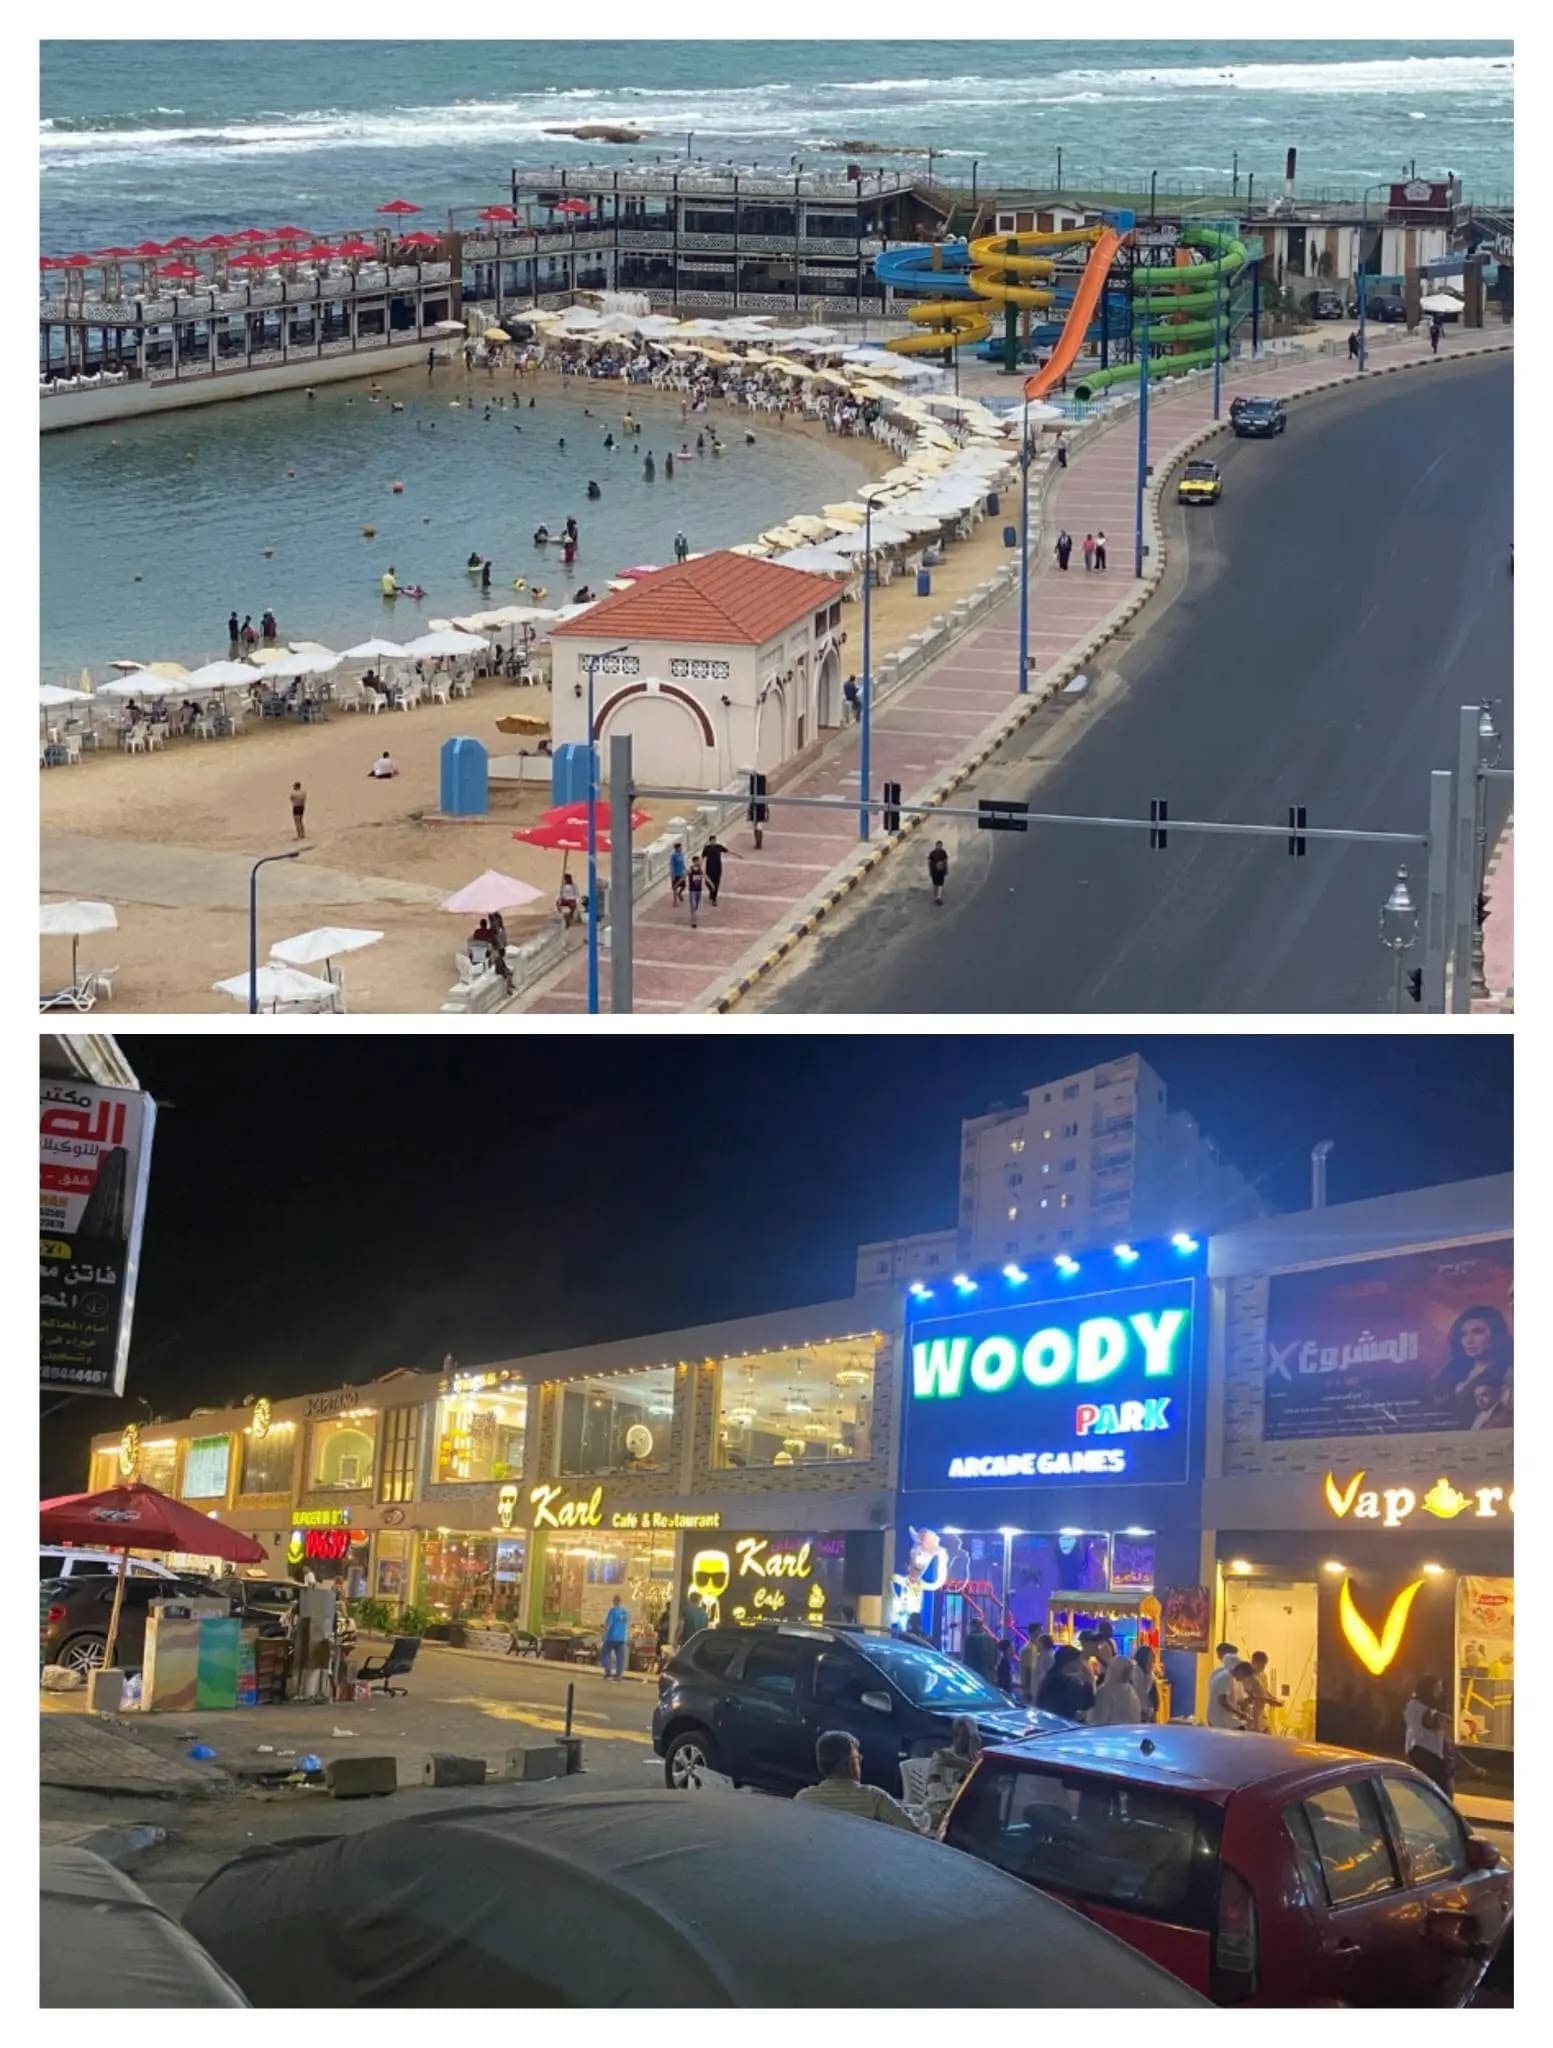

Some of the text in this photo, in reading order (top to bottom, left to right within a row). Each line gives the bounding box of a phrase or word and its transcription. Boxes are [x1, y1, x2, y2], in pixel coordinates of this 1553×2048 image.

[912, 1309, 1189, 1400] WOODY
[1299, 1330, 1418, 1374] المشروع
[1076, 1398, 1170, 1436] PARK
[948, 1448, 1126, 1479] ARCADE GAMES
[530, 1484, 603, 1529] Karl
[641, 1511, 652, 1528] &
[652, 1511, 720, 1529] Restaurant
[735, 1538, 811, 1578] Karl
[753, 1587, 786, 1611] Cafe
